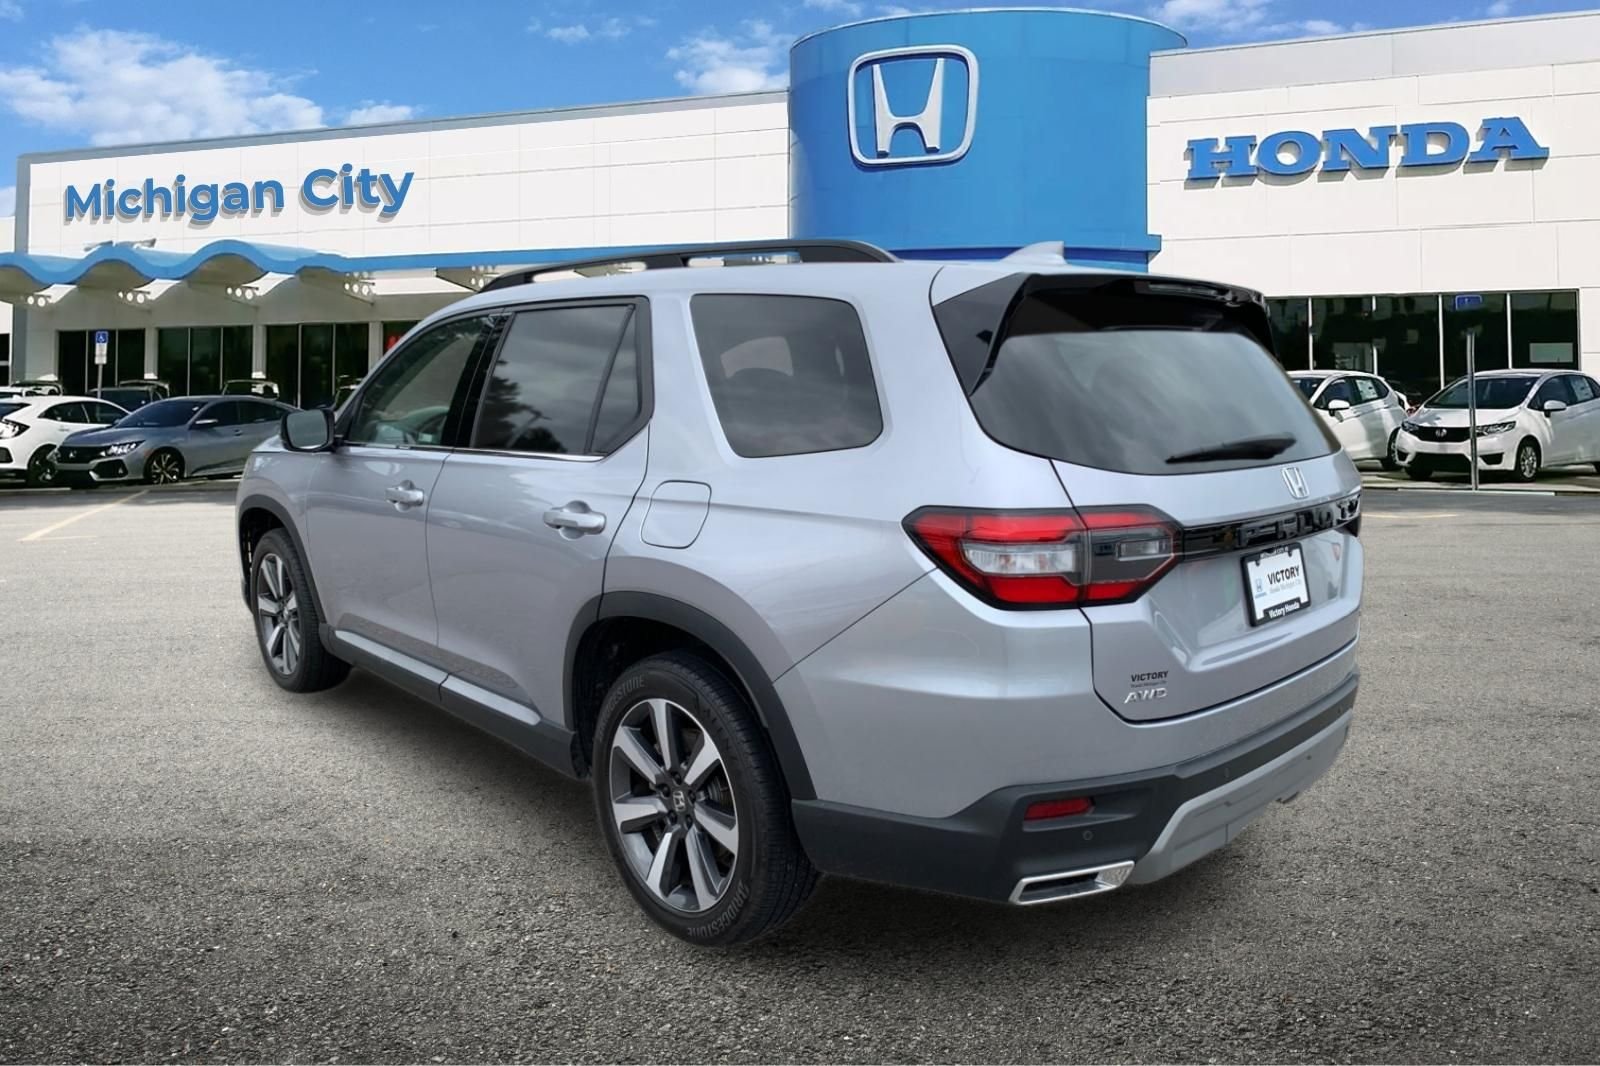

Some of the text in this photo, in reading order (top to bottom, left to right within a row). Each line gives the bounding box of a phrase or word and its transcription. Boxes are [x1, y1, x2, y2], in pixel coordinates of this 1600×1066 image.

[1185, 116, 1550, 186] HONDA
[65, 163, 415, 223] Michigan City
[1266, 565, 1300, 585] VICTORY
[1268, 601, 1300, 619] Victory Honda
[1130, 671, 1169, 682] VICTORY
[1124, 687, 1168, 704] AWD
